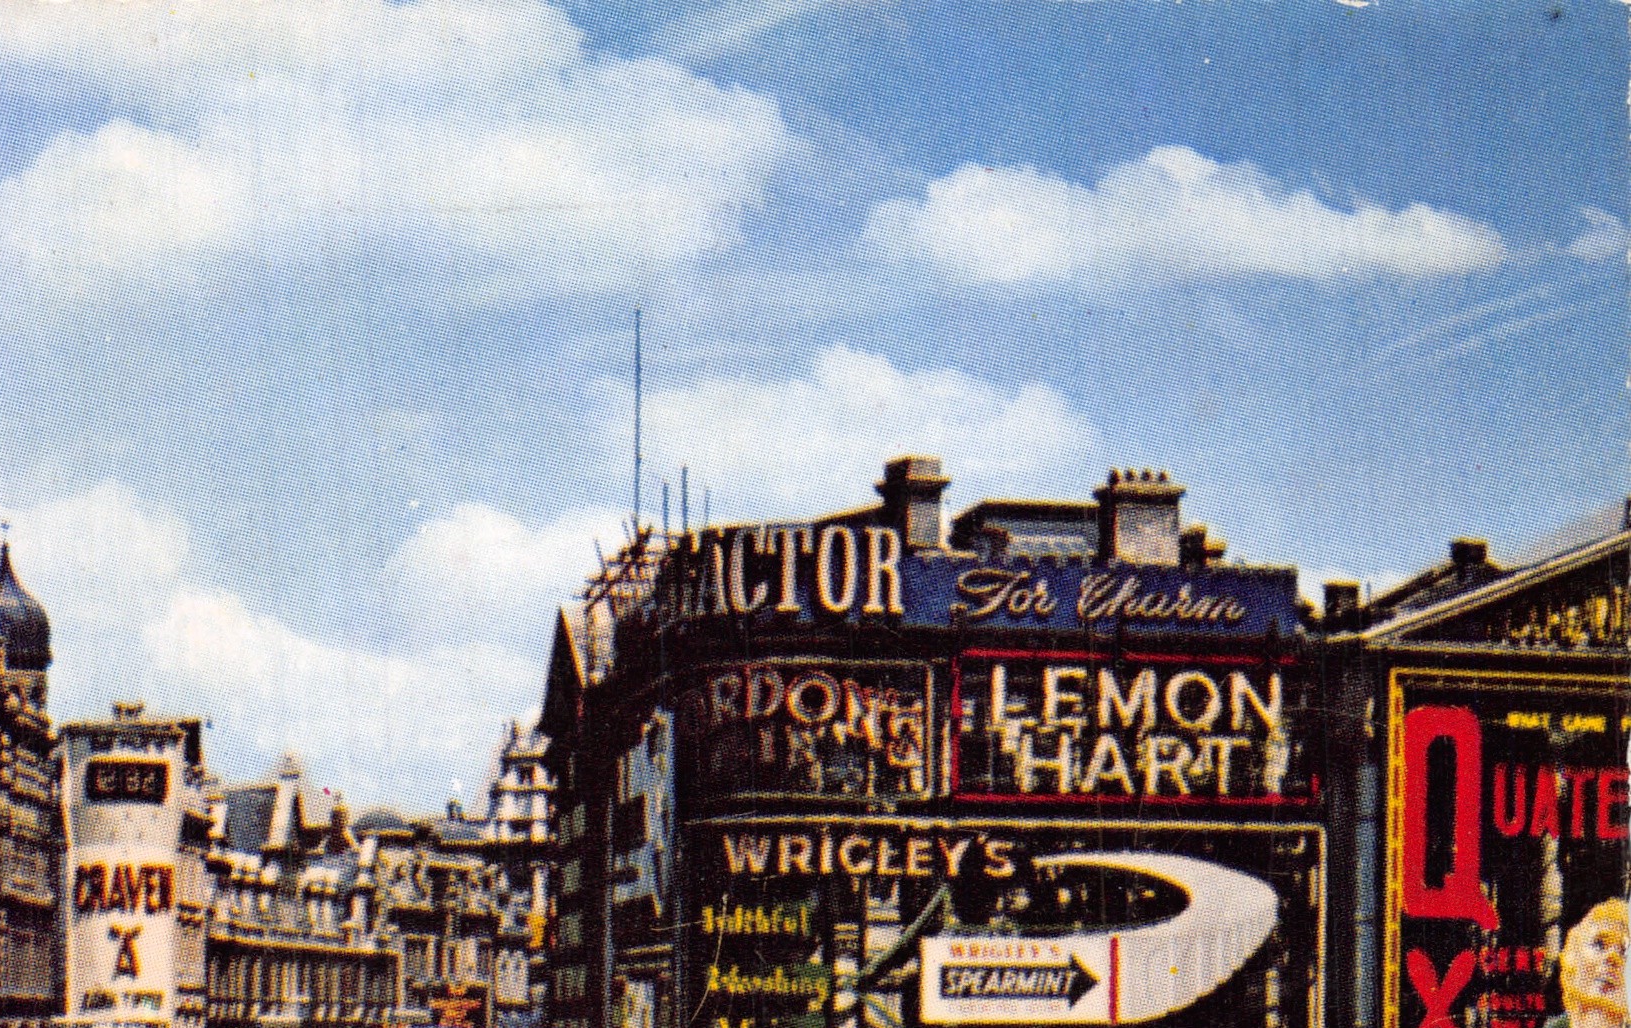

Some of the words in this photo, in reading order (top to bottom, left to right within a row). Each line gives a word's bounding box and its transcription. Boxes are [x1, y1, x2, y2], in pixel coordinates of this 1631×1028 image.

[950, 568, 1057, 617] For
[1078, 573, 1247, 621] Charm
[991, 663, 1282, 731] LEMON
[1016, 733, 1251, 796] HART
[722, 832, 1017, 878] WRIGLEY'S
[75, 863, 175, 915] CRAVEN
[944, 968, 1077, 996] SPEARMINT
